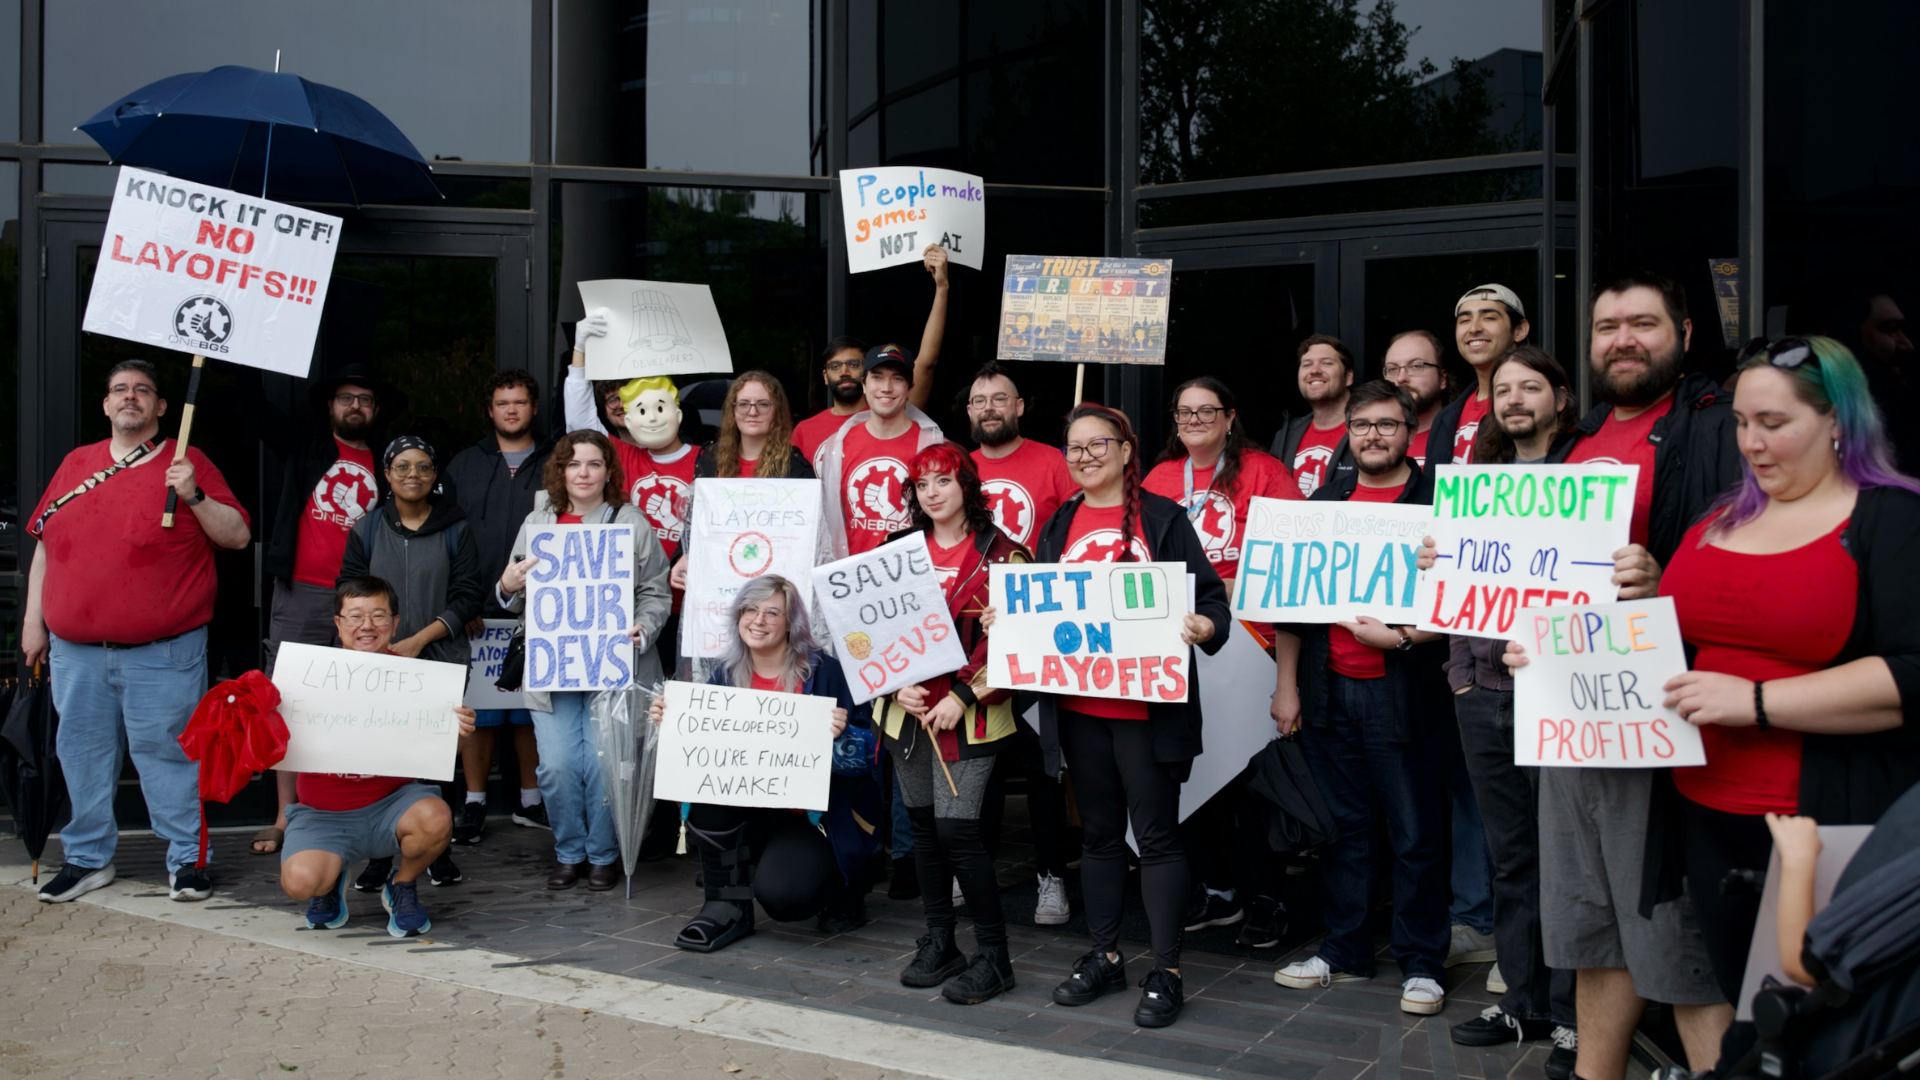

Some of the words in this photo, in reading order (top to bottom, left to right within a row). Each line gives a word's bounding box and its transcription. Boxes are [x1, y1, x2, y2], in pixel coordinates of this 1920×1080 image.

[857, 171, 936, 207] People
[942, 181, 982, 202] make
[125, 177, 228, 219] KNOCK
[237, 204, 267, 227] IT
[274, 214, 334, 244] OFF!
[855, 208, 926, 243] games
[196, 219, 255, 255] NO
[880, 231, 918, 259] NOT
[939, 231, 962, 254] AI
[110, 234, 317, 305] LAYOFFS!!!
[1041, 258, 1100, 277] TRUST
[1016, 277, 1028, 292] T
[1045, 278, 1060, 293] R
[1078, 279, 1093, 294] U
[1110, 280, 1123, 296] S
[1145, 280, 1157, 296] T
[168, 335, 230, 354] ONEBGS
[632, 353, 694, 369] DEVELOPERS
[722, 485, 799, 506] XBOX
[1434, 472, 1629, 522] MICROSOFT
[312, 509, 355, 527] ONEB
[711, 510, 805, 528] LAYOFFS
[1250, 502, 1325, 539] Devs
[1332, 510, 1428, 538] Deserve
[531, 528, 631, 583] SAVE
[828, 545, 930, 600] SAVE
[1457, 536, 1512, 575] runs
[1530, 546, 1559, 582] on
[1004, 570, 1092, 615] HIT
[1237, 539, 1424, 611] FAIRPLAY
[533, 583, 627, 632] OUR
[860, 591, 921, 626] OUR
[1053, 620, 1113, 655] ON
[1533, 611, 1657, 658] PEOPLE
[528, 633, 632, 689] DEVS
[858, 612, 951, 695] DEVS
[302, 659, 425, 693] LAYOFFS
[1006, 653, 1187, 702] LAYOFFS
[1570, 670, 1652, 712] OVER
[364, 708, 410, 728] disliked
[688, 688, 736, 712] HEY
[756, 696, 796, 717] YOU
[677, 712, 799, 738] (DEVELOPERS!)
[1537, 718, 1675, 763] PROFITS
[683, 746, 749, 768] YOU'RE
[758, 750, 821, 770] FINALLY
[697, 774, 788, 796] AWAKE!
